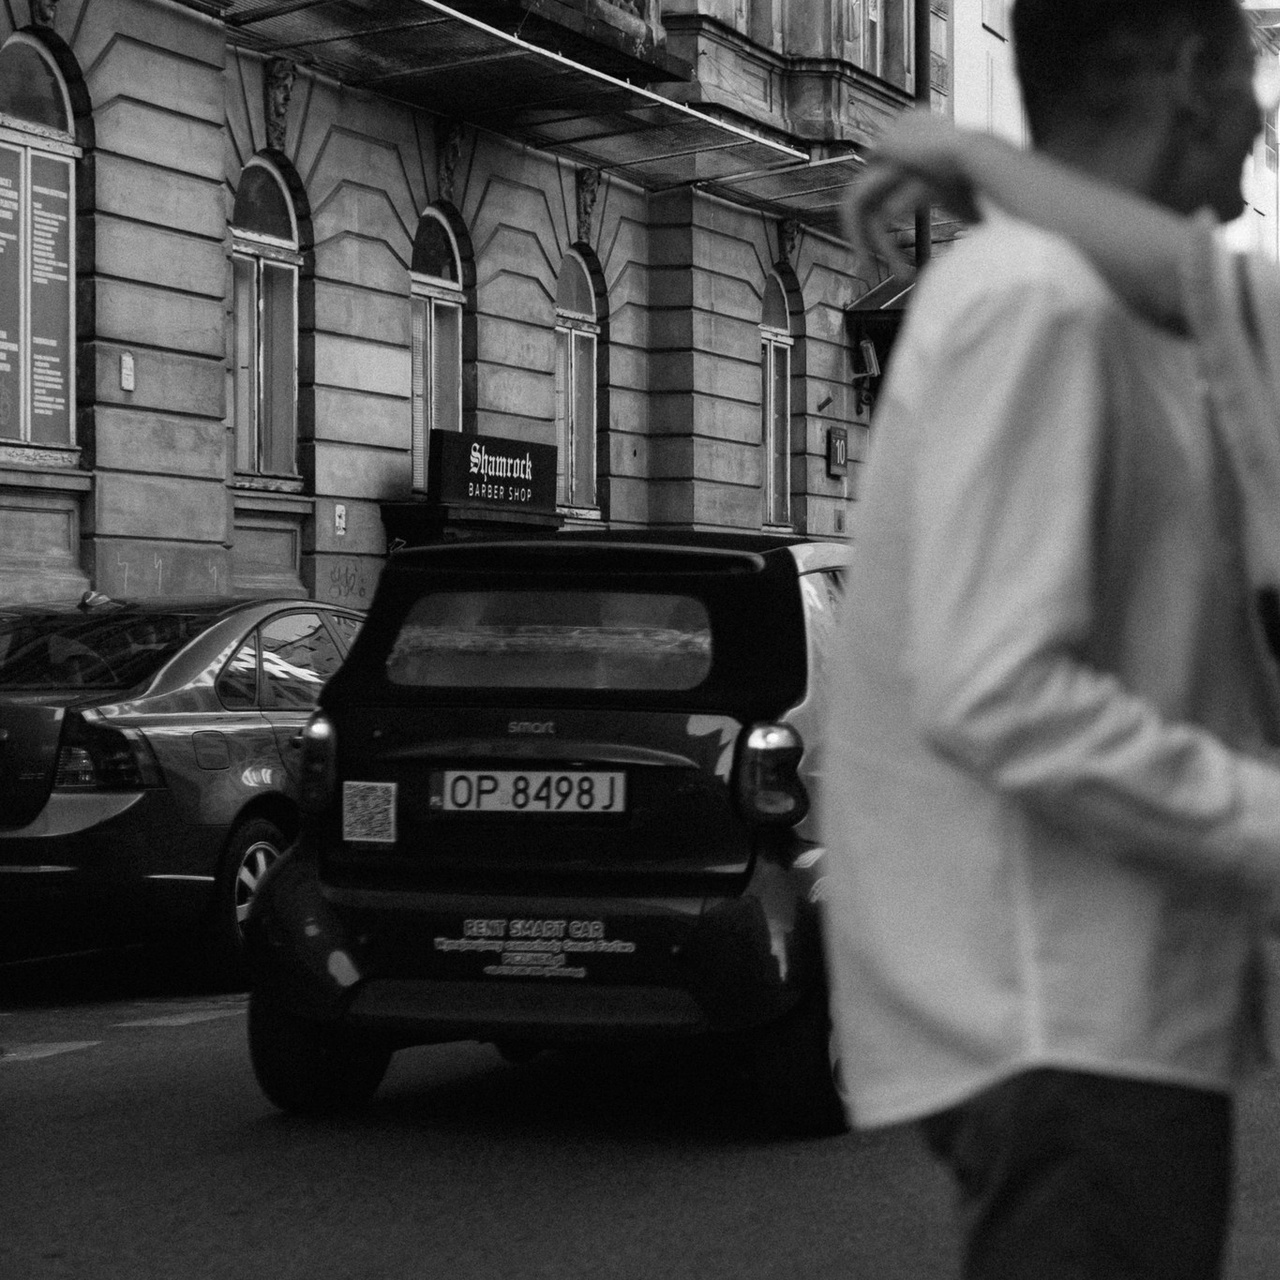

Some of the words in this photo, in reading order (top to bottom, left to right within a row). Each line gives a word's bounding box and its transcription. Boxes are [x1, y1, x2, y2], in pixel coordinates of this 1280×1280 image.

[468, 442, 533, 482] Shamrock
[835, 439, 846, 465] 10
[468, 482, 505, 499] BARBER
[508, 486, 532, 501] SHOP
[508, 721, 555, 734] smart
[451, 775, 499, 809] OP
[511, 775, 616, 811] 8498J
[463, 919, 507, 937] RENT
[509, 919, 567, 938] SMART
[569, 920, 606, 939] CAR
